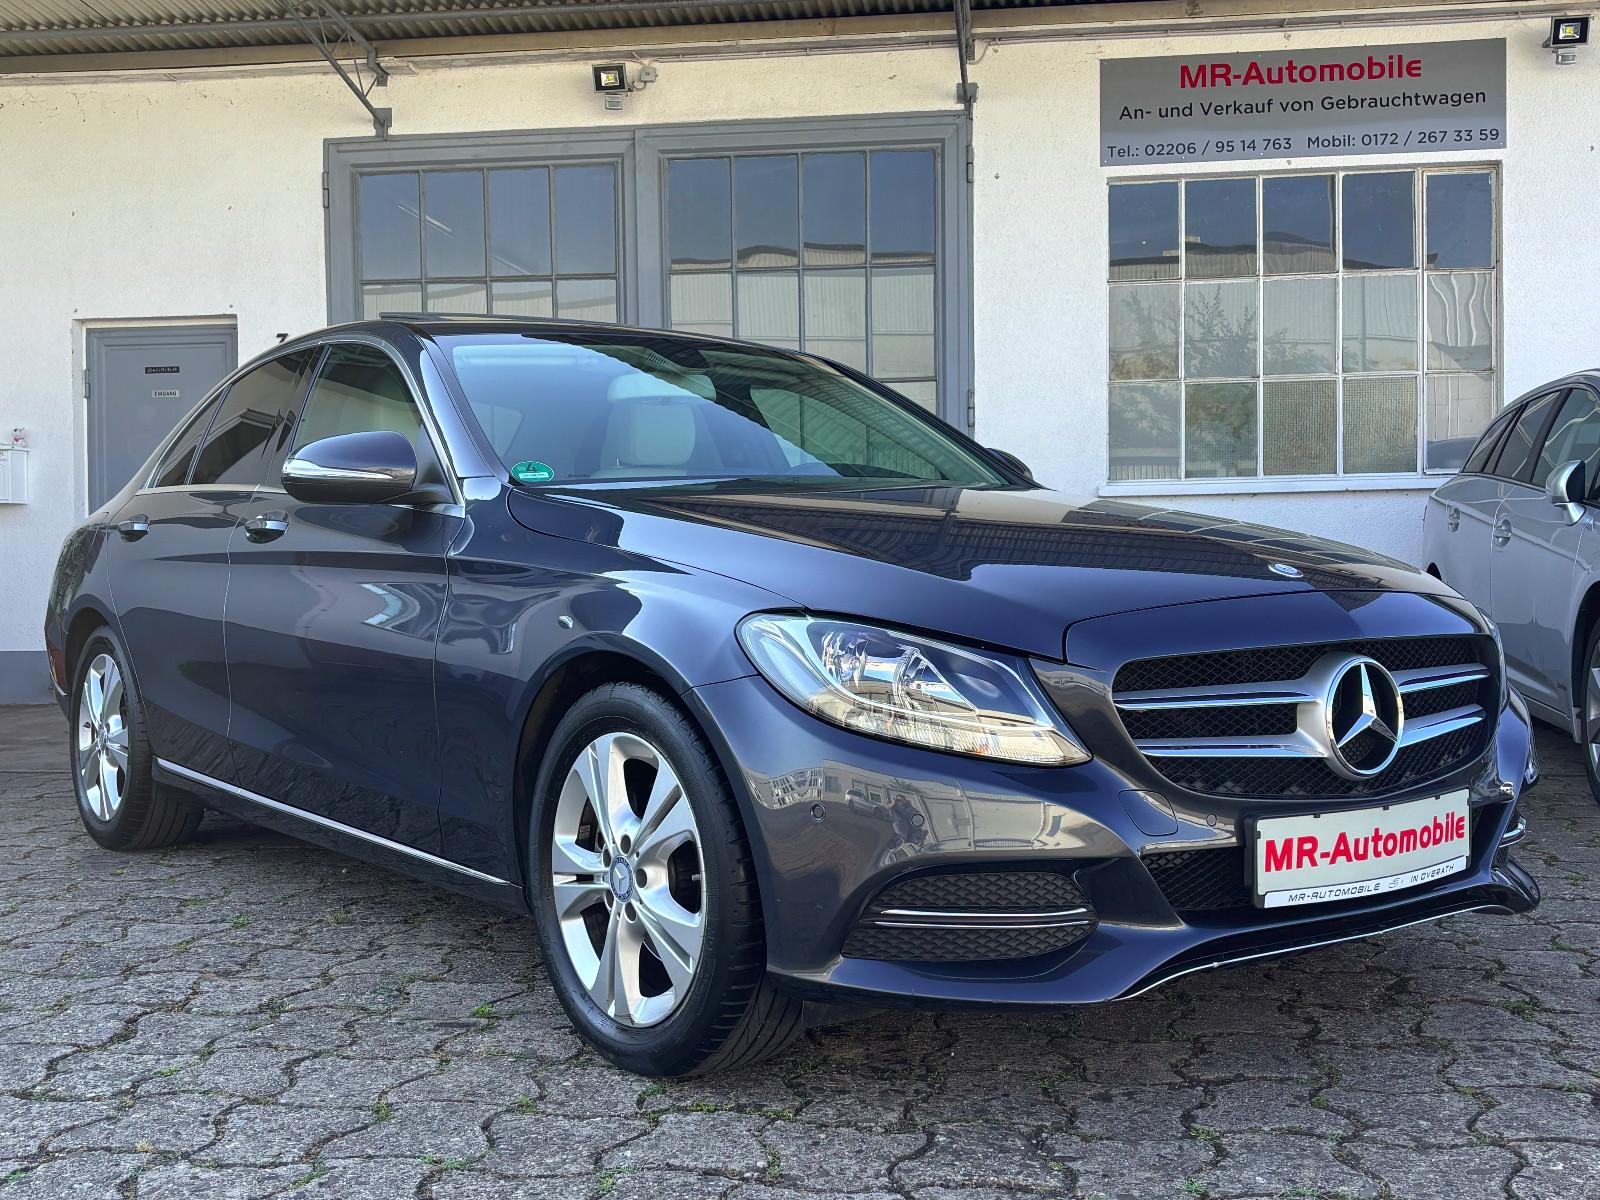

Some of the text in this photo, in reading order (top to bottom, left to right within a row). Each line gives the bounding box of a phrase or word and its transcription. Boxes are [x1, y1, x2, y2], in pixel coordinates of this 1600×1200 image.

[1180, 54, 1422, 88] MR-Automobile
[1119, 91, 1486, 120] An- und Verkauf von Gebrauchtwagen
[1107, 128, 1500, 158] Tel.: 02206 / 95 14 763 Mobil: 0172 / 267 33 59
[1264, 811, 1465, 873] MR-Automobile
[1288, 864, 1455, 903] MR-AUTOMOBILE IN OVERATH
